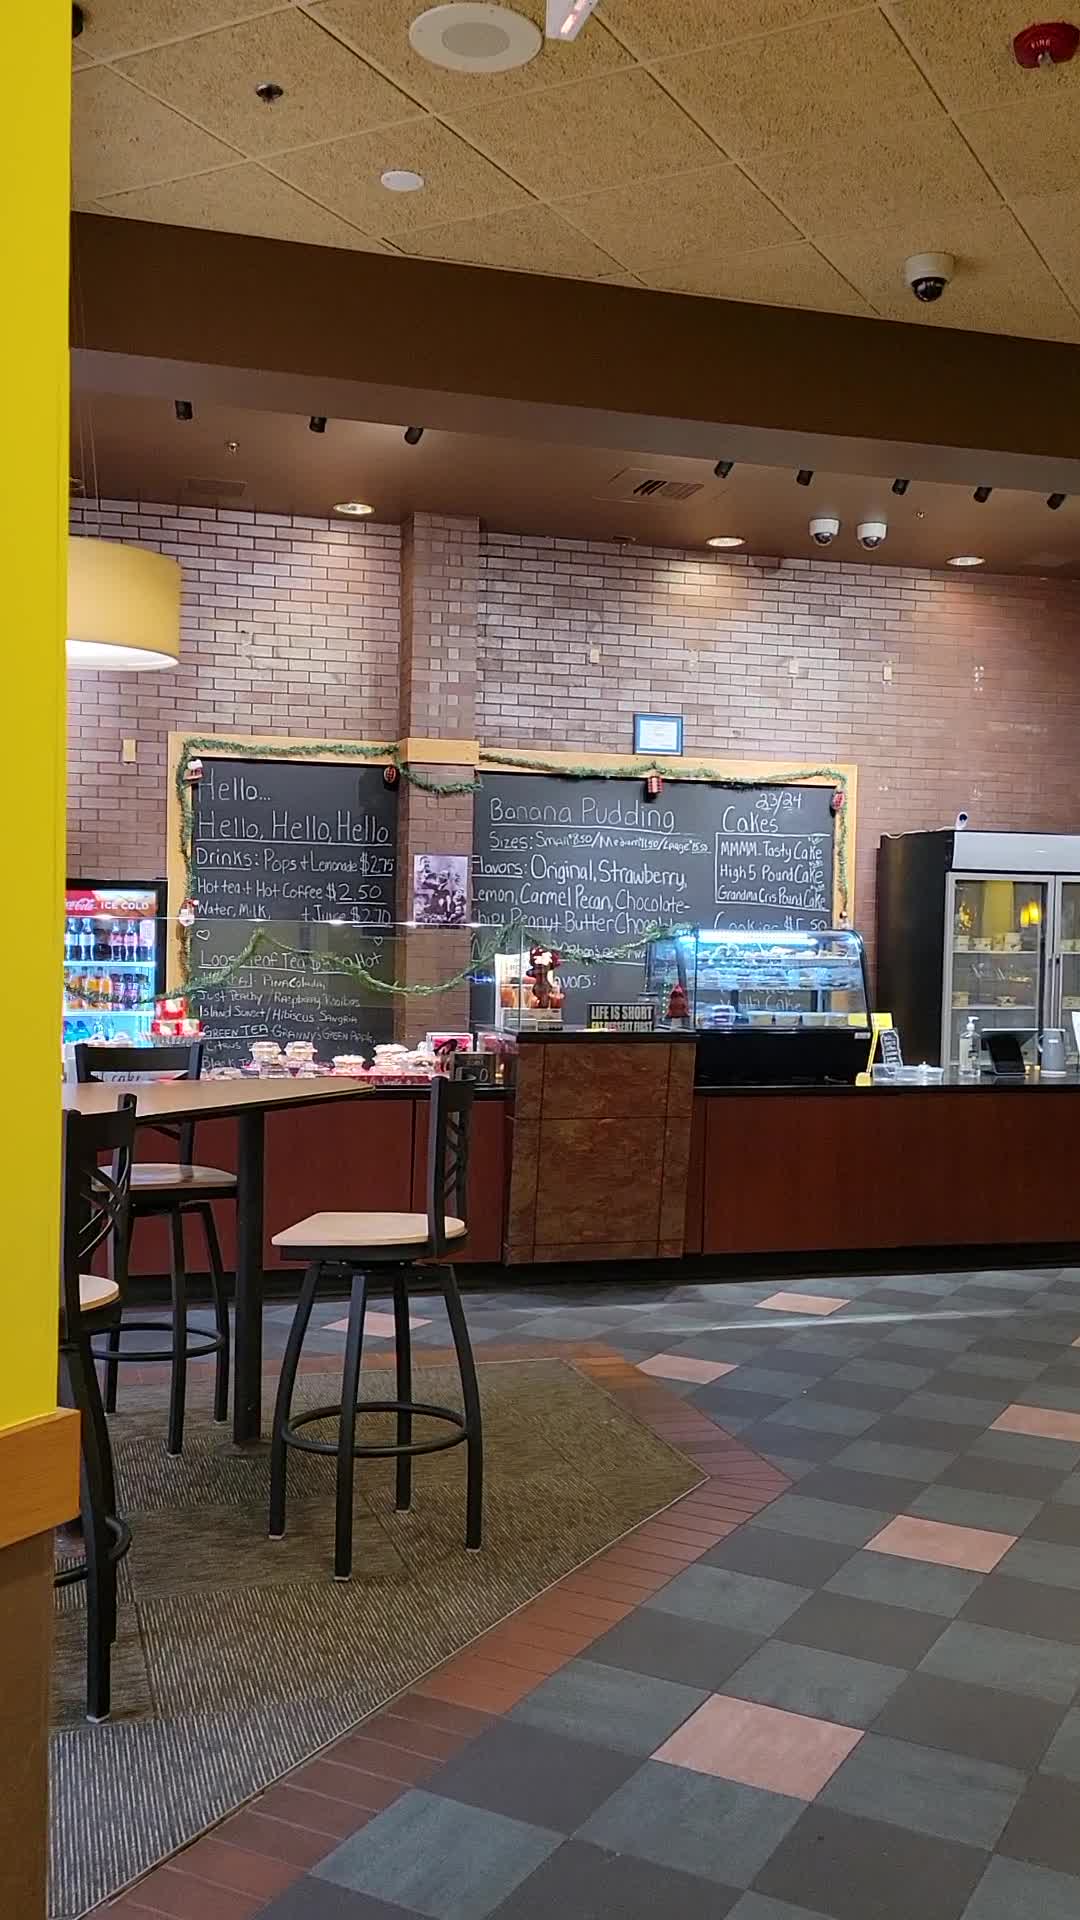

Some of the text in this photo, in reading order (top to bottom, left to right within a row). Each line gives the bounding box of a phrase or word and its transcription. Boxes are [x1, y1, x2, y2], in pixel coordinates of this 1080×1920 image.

[755, 791, 803, 815] 23/24
[198, 810, 390, 845] Hello, Hello, Hello
[490, 797, 676, 834] Banana Pudding
[722, 805, 779, 834] Cakes
[489, 830, 534, 851] Sizes:
[763, 840, 792, 863] Tasty
[793, 840, 823, 861] Cake
[196, 847, 259, 868] Drinks:
[263, 848, 298, 875] Pops
[310, 850, 358, 872] Lemonade
[599, 859, 688, 890] Strawberry,
[720, 863, 747, 884] High
[748, 864, 757, 881] 5
[762, 864, 794, 882] Pound
[794, 864, 825, 884] Cake
[197, 877, 219, 894] Hot
[221, 879, 241, 894] tea
[256, 879, 281, 898] Hot
[282, 882, 323, 899] Coffee
[326, 882, 382, 901] $2.50
[520, 882, 573, 907] Carmel
[575, 884, 614, 912] Pecan,
[717, 884, 758, 902] Grandma
[758, 887, 778, 903] Cris
[778, 886, 803, 907] Pound
[803, 888, 828, 909] Cake
[100, 901, 150, 910] ICE COLD
[197, 900, 237, 918] Water,
[473, 909, 504, 925] hip,
[565, 911, 613, 933] Butter
[613, 911, 686, 936] Chocolt
[200, 949, 247, 967] Loos
[281, 952, 306, 971] Tea
[553, 974, 597, 990] avors:
[591, 1005, 653, 1020] LIFE IS SHORT
